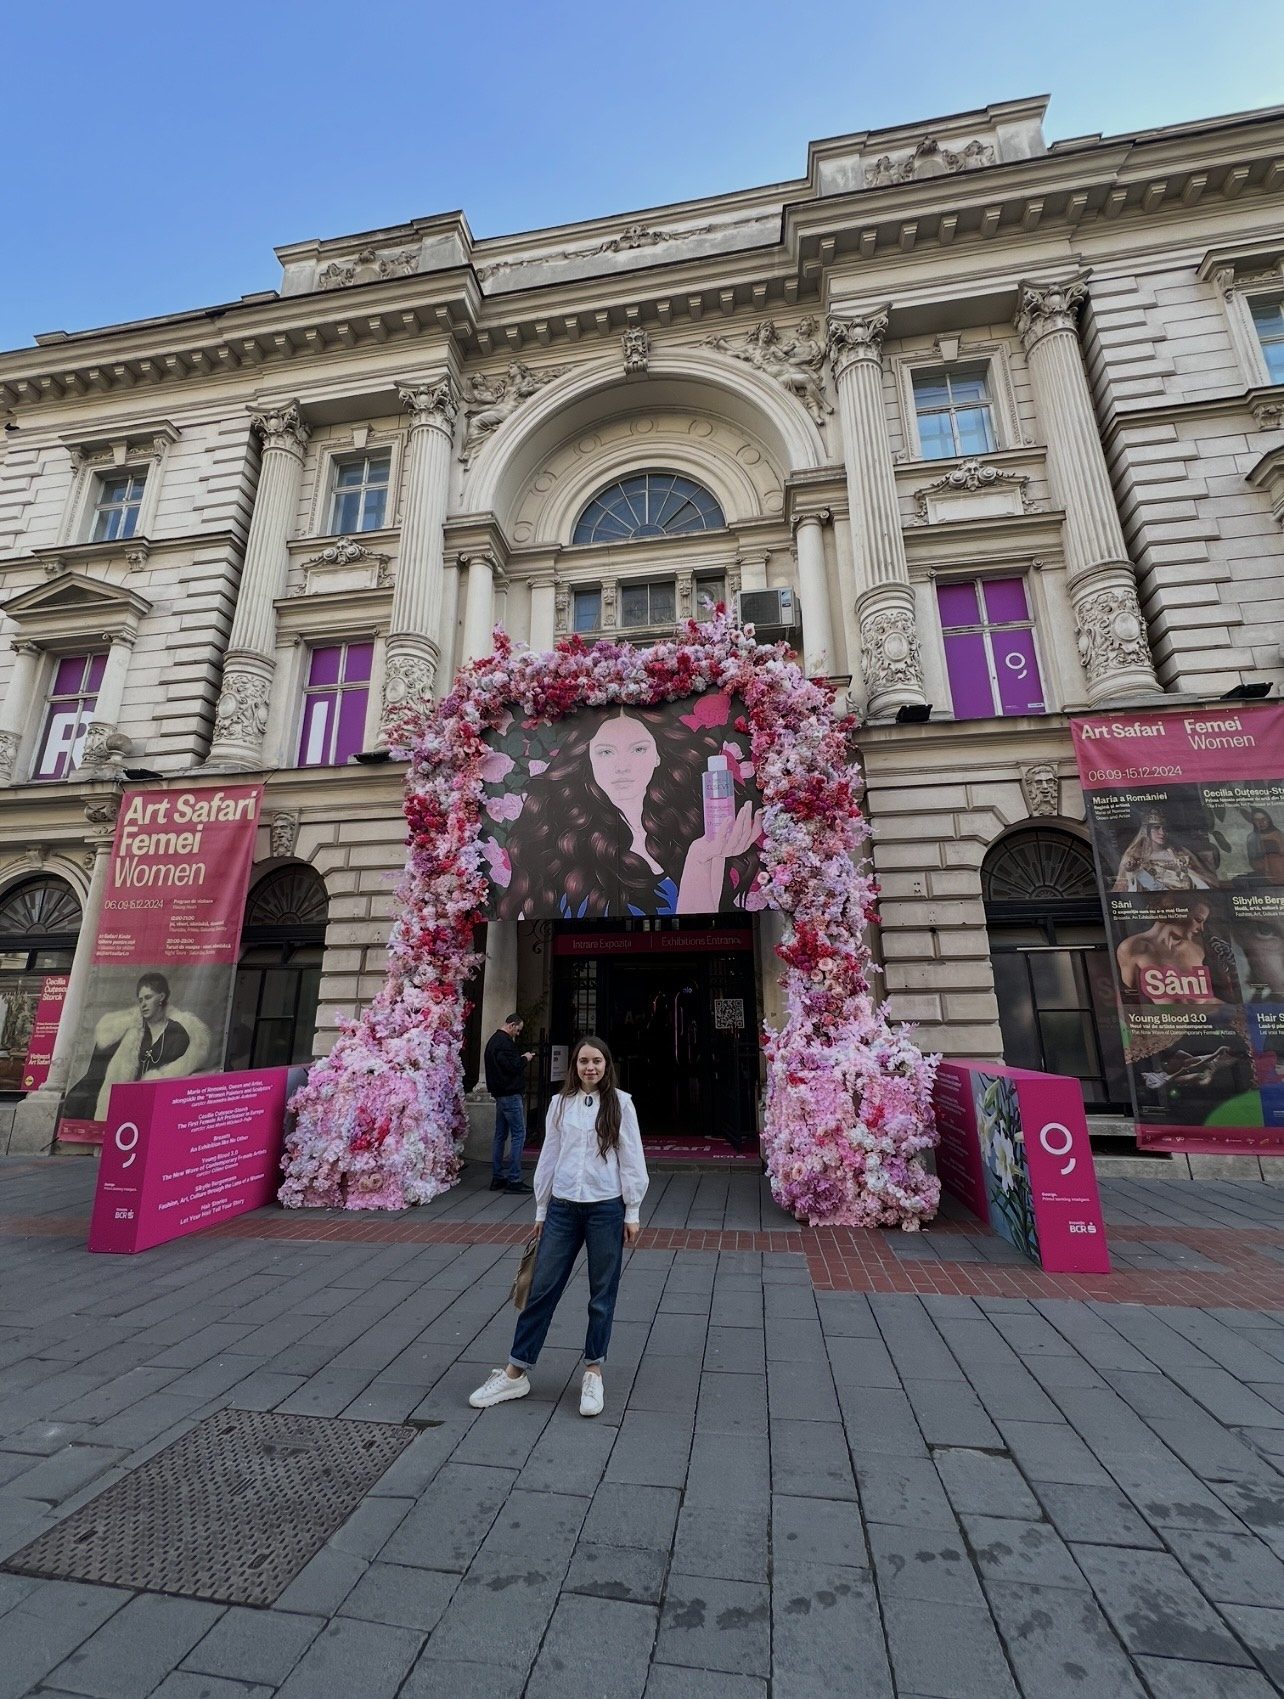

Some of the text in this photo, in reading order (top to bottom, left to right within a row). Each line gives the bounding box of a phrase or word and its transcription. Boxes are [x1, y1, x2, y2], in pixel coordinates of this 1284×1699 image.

[1081, 721, 1166, 740] Art Safari
[1183, 716, 1242, 734] Femei
[1188, 734, 1256, 751] Women
[1088, 765, 1183, 782] 06.09-15.12.2024
[1092, 795, 1118, 804] Maria
[1125, 791, 1168, 802] României
[1203, 787, 1284, 797] Cecilia Cuțescu-St
[124, 791, 257, 826] Art Safari
[119, 824, 203, 857] Femei
[114, 857, 206, 888] Women
[1111, 900, 1133, 909] Sâni
[1232, 896, 1264, 906] Sibylle
[1144, 969, 1209, 995] Sâni
[42, 993, 63, 1001] Storck
[1128, 1013, 1207, 1025] Young Blood 3.0
[1256, 1013, 1276, 1022] Hair
[114, 1211, 127, 1219] BCR
[1070, 1224, 1087, 1233] BCR
